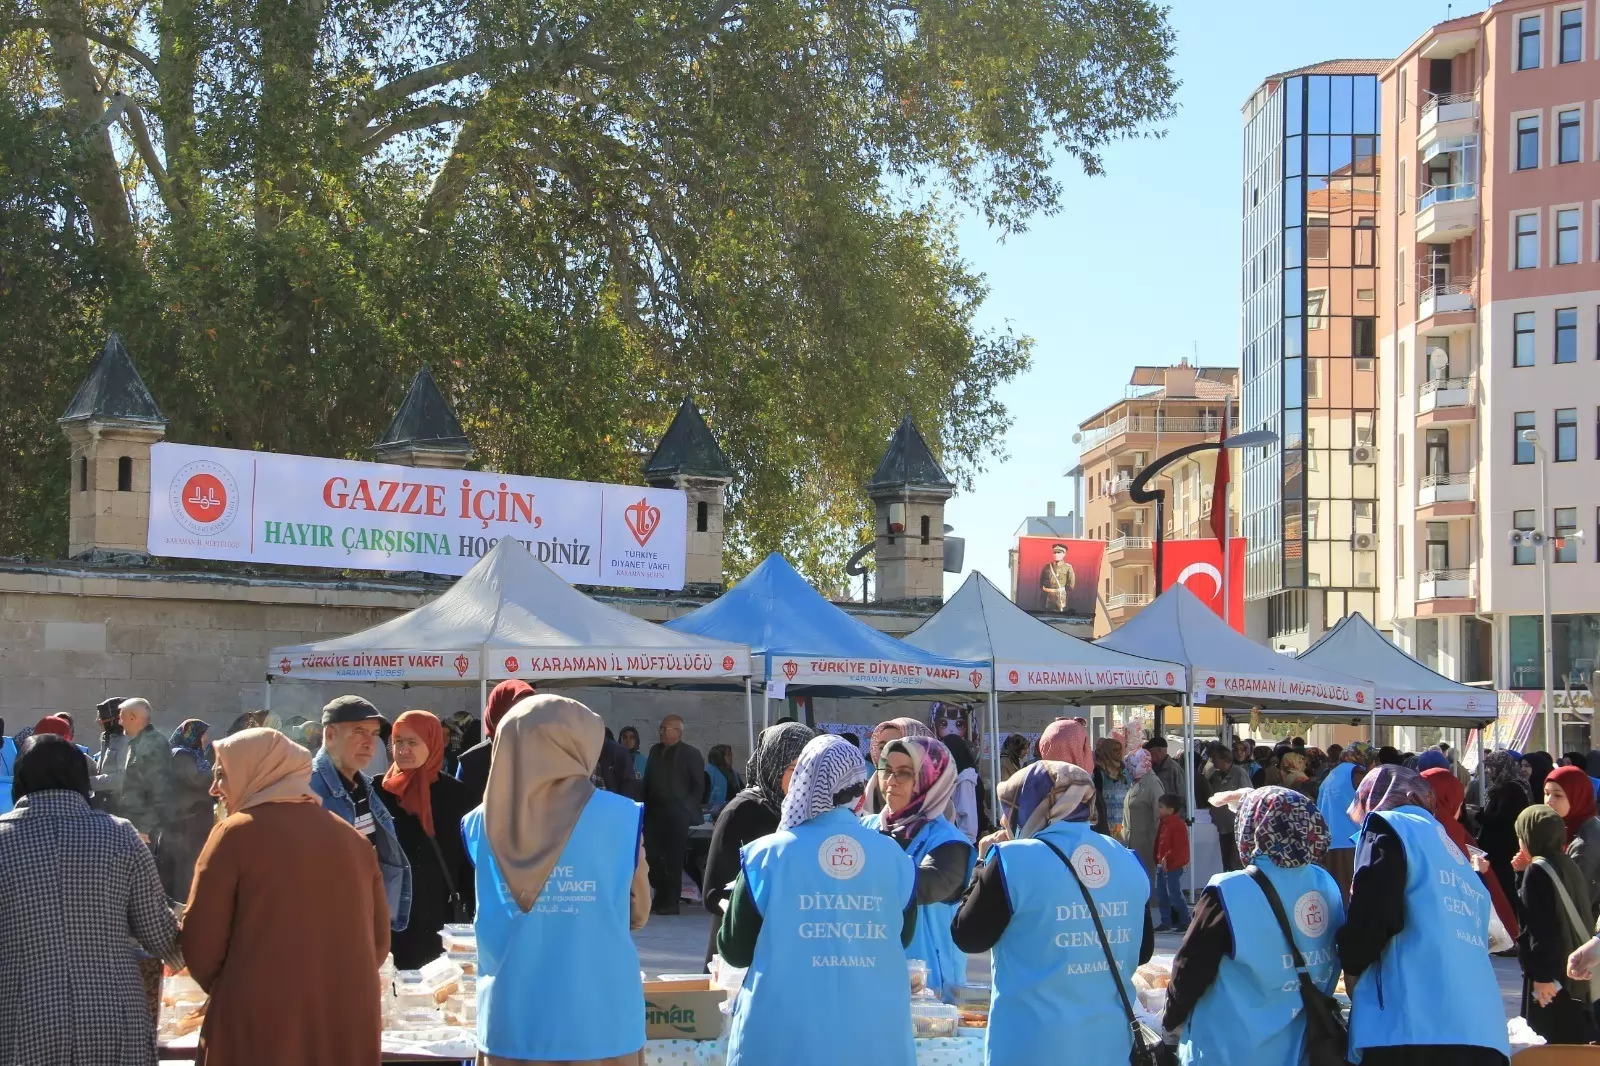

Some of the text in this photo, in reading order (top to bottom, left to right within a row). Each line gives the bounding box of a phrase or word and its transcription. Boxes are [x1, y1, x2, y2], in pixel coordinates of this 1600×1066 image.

[323, 477, 543, 529] GAZZE İÇİN,
[264, 520, 334, 547] HAYIR
[341, 526, 451, 558] ÇARŞISINA
[624, 548, 658, 559] TÜRKİYE
[611, 557, 670, 570] DİYANET VAKFI
[301, 652, 443, 668] TÜRKİYE DİYANET VAKFI
[531, 653, 712, 672] KARAMAN İL MÜFTÜLÜĞÜ
[336, 669, 373, 677] KARAMAN
[811, 659, 960, 679] TÜRKİYE DİYANET VAKFI
[1028, 669, 1158, 686] KARAMAN İL MÜFTÜLÜĞÜ
[850, 674, 889, 684] KARAMAN
[1224, 678, 1349, 701] KARAMAN İL MÜFTÜLÜĞÜ
[1375, 695, 1433, 713] ENÇLİK
[557, 880, 596, 892] VAKFI
[553, 895, 596, 903] FOUNDATION
[799, 892, 883, 911] DİYANET
[799, 920, 888, 943] GENÇLİK
[812, 956, 876, 968] KARAMAN
